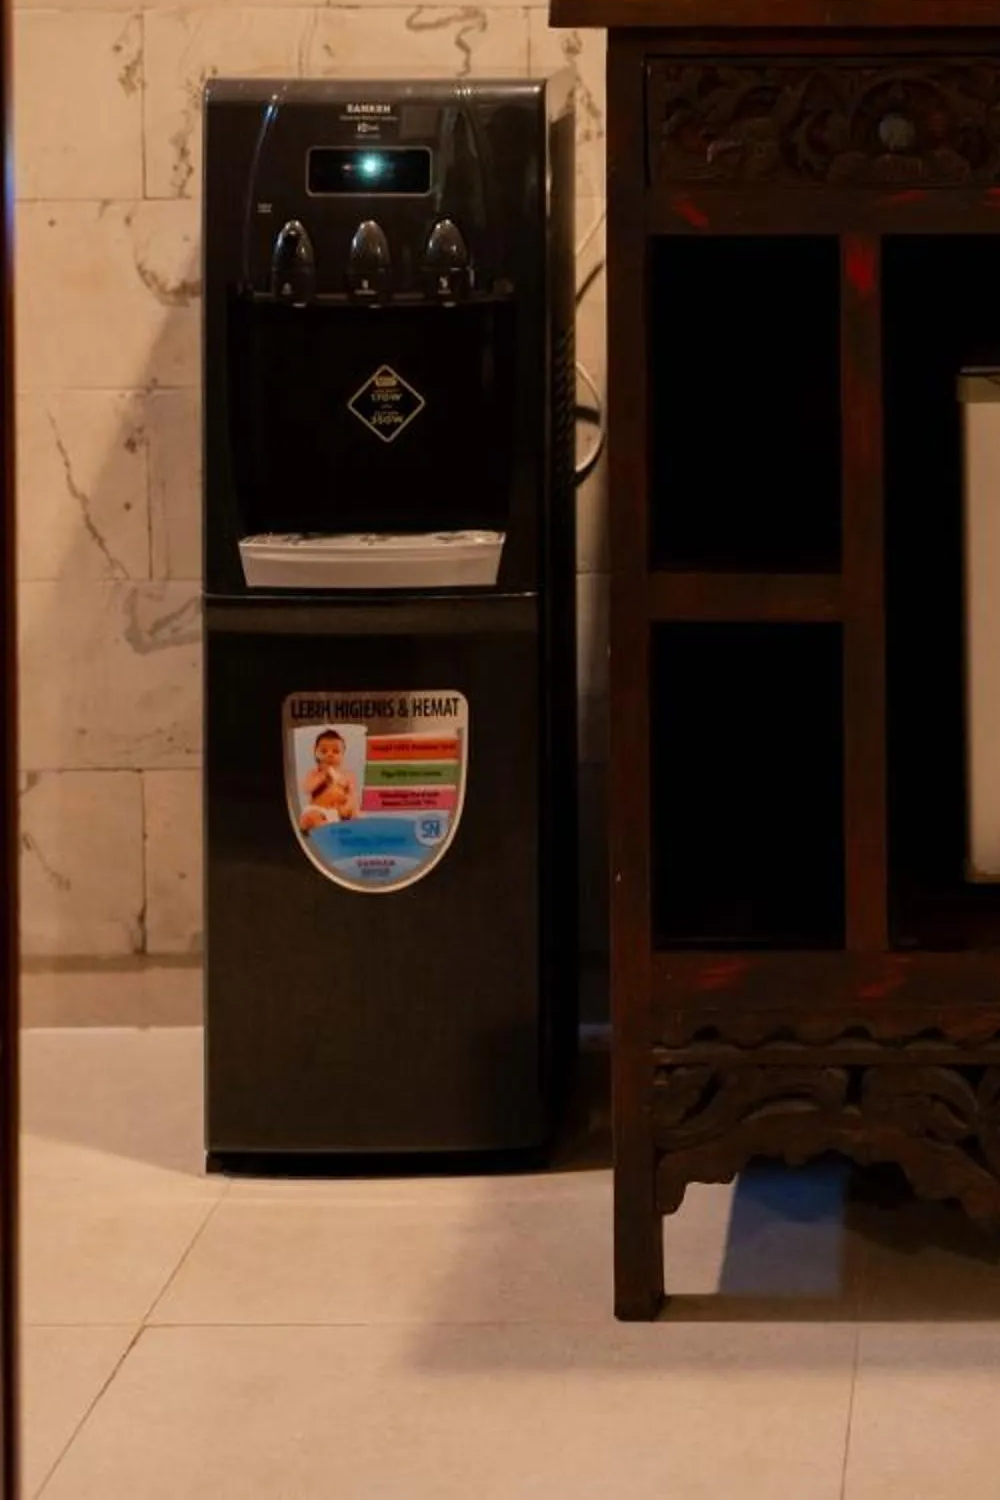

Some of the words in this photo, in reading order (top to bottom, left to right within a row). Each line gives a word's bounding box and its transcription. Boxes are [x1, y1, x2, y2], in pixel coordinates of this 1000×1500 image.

[292, 700, 331, 719] LEBIH
[334, 699, 394, 719] HIGIENIS
[397, 699, 409, 718] &
[412, 697, 459, 717] HEMAT
